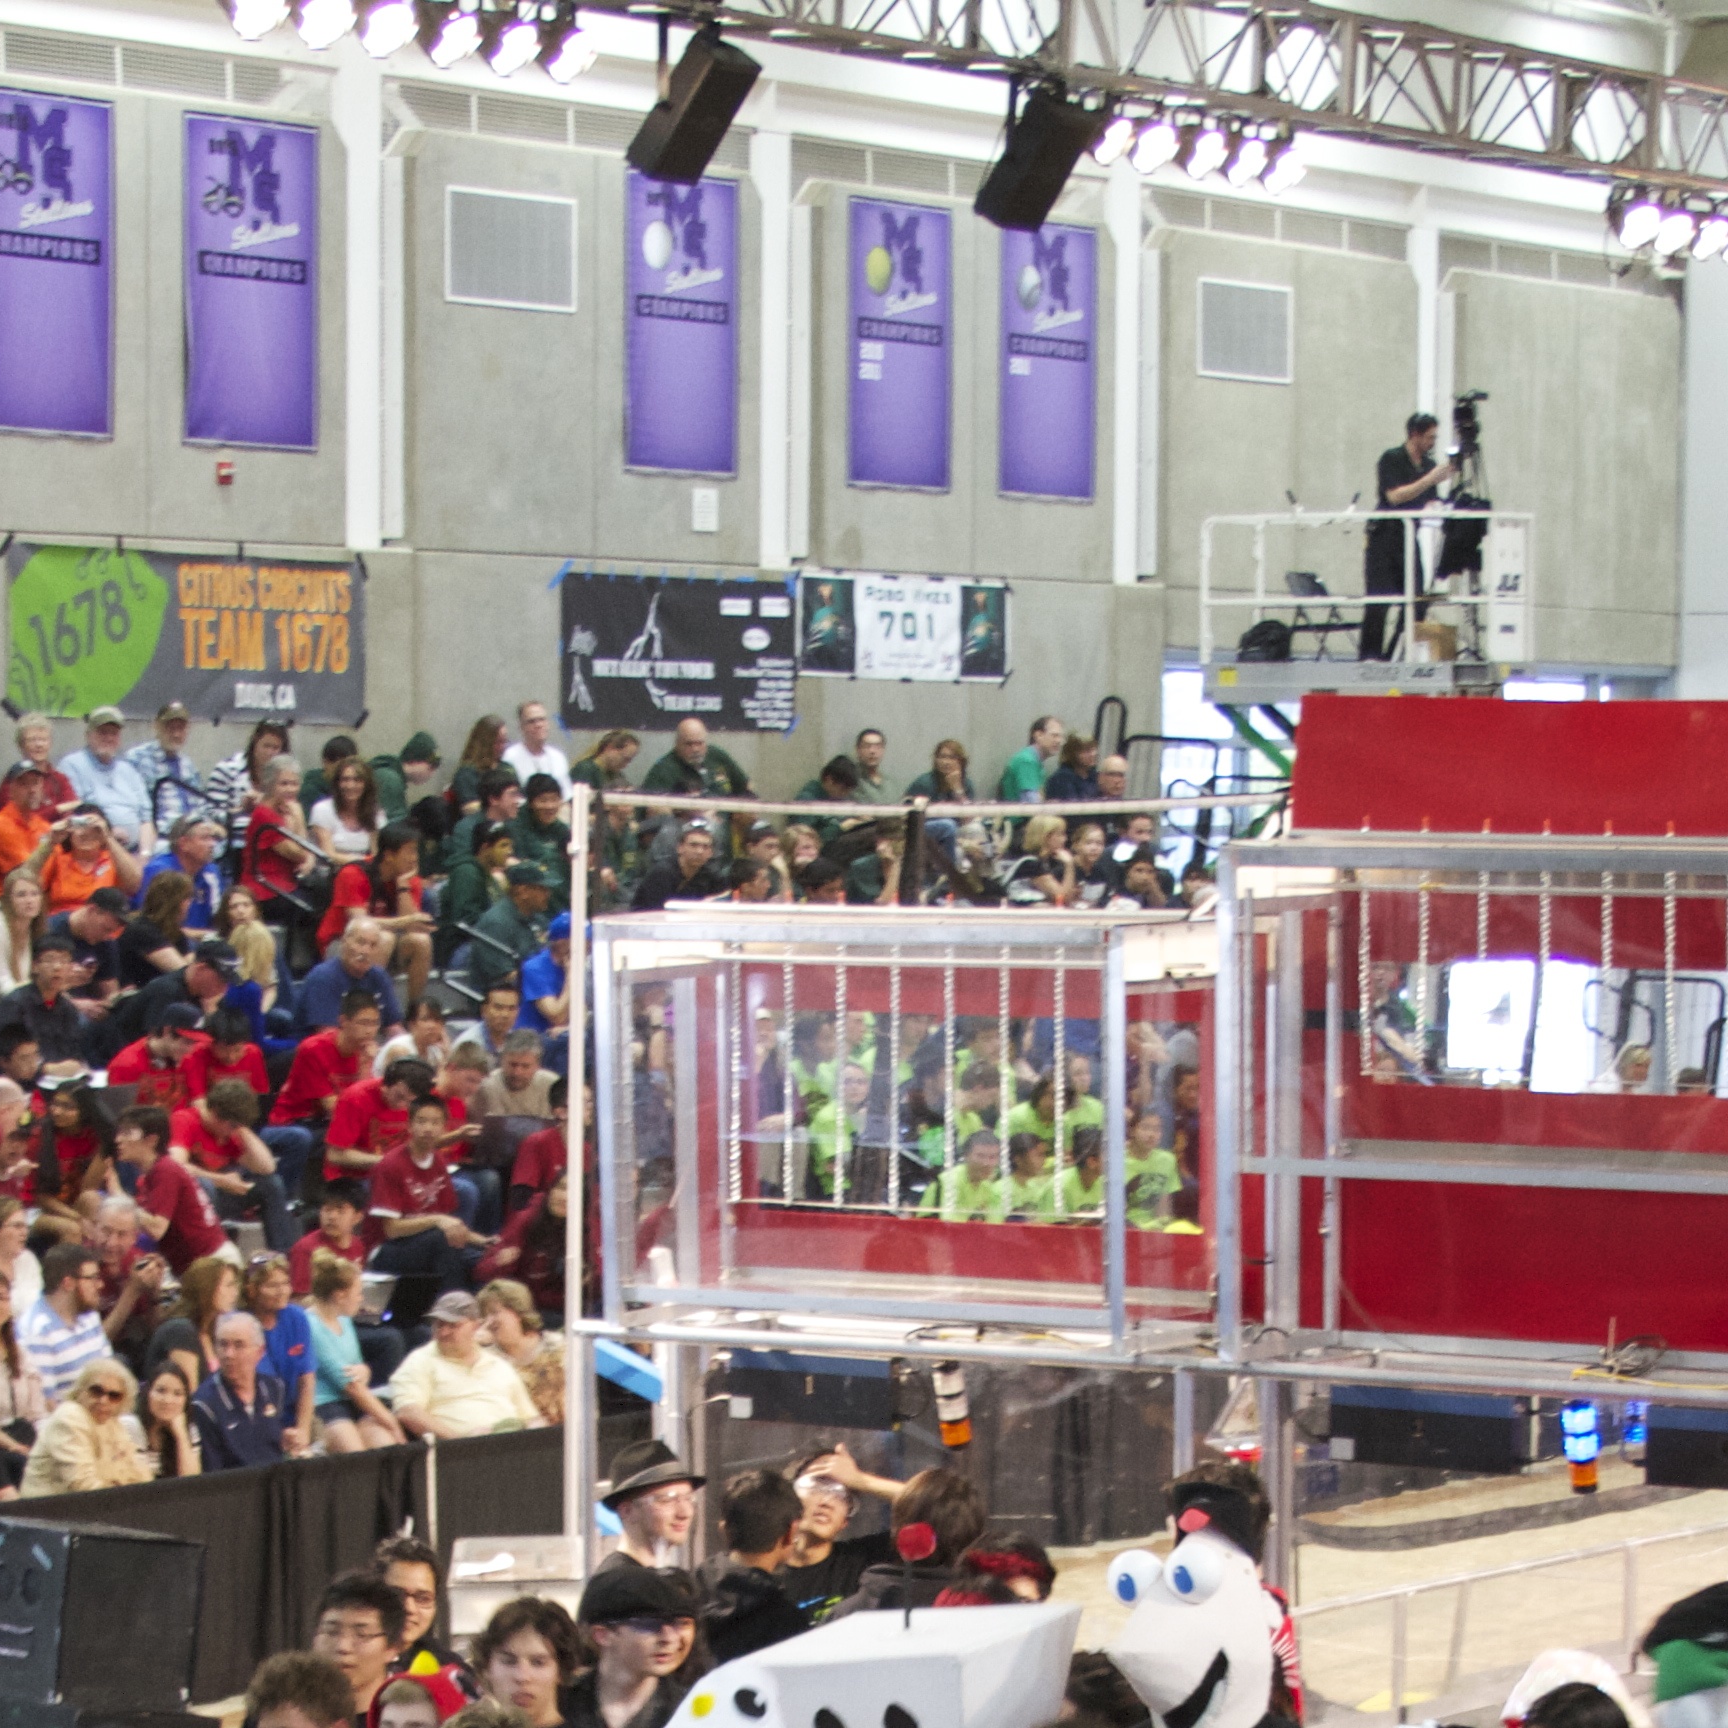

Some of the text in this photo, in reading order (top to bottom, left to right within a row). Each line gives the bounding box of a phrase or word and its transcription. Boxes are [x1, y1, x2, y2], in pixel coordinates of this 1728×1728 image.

[28, 579, 131, 676] 1678
[178, 608, 350, 674] TEAM 1678
[878, 610, 935, 640] 701
